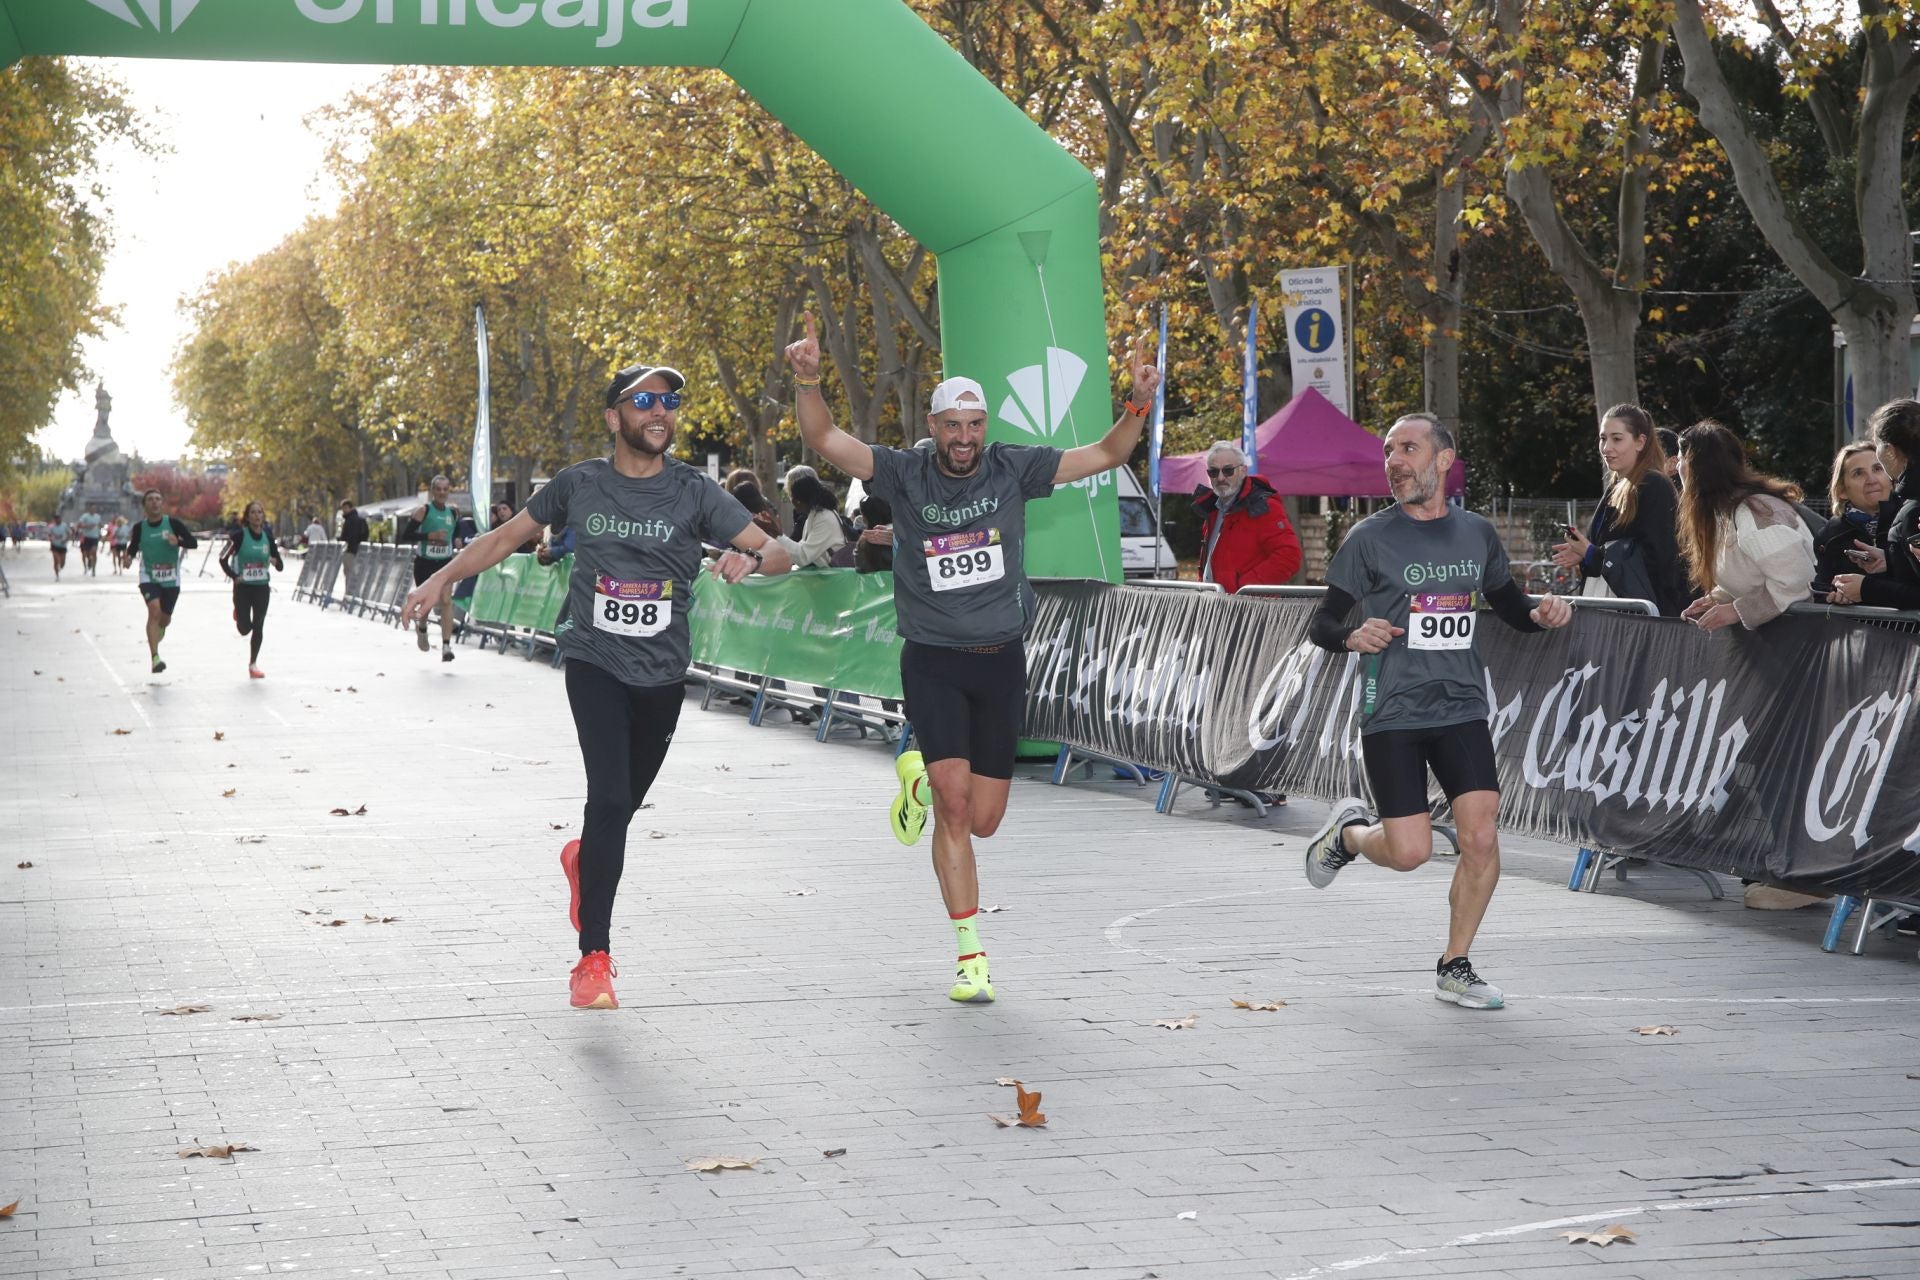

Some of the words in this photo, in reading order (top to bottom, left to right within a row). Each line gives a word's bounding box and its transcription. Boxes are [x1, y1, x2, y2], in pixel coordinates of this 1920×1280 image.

[1314, 276, 1324, 284] de
[938, 550, 992, 579] 899
[603, 599, 658, 626] 898
[1420, 615, 1471, 639] 900
[1365, 678, 1377, 704] RUN
